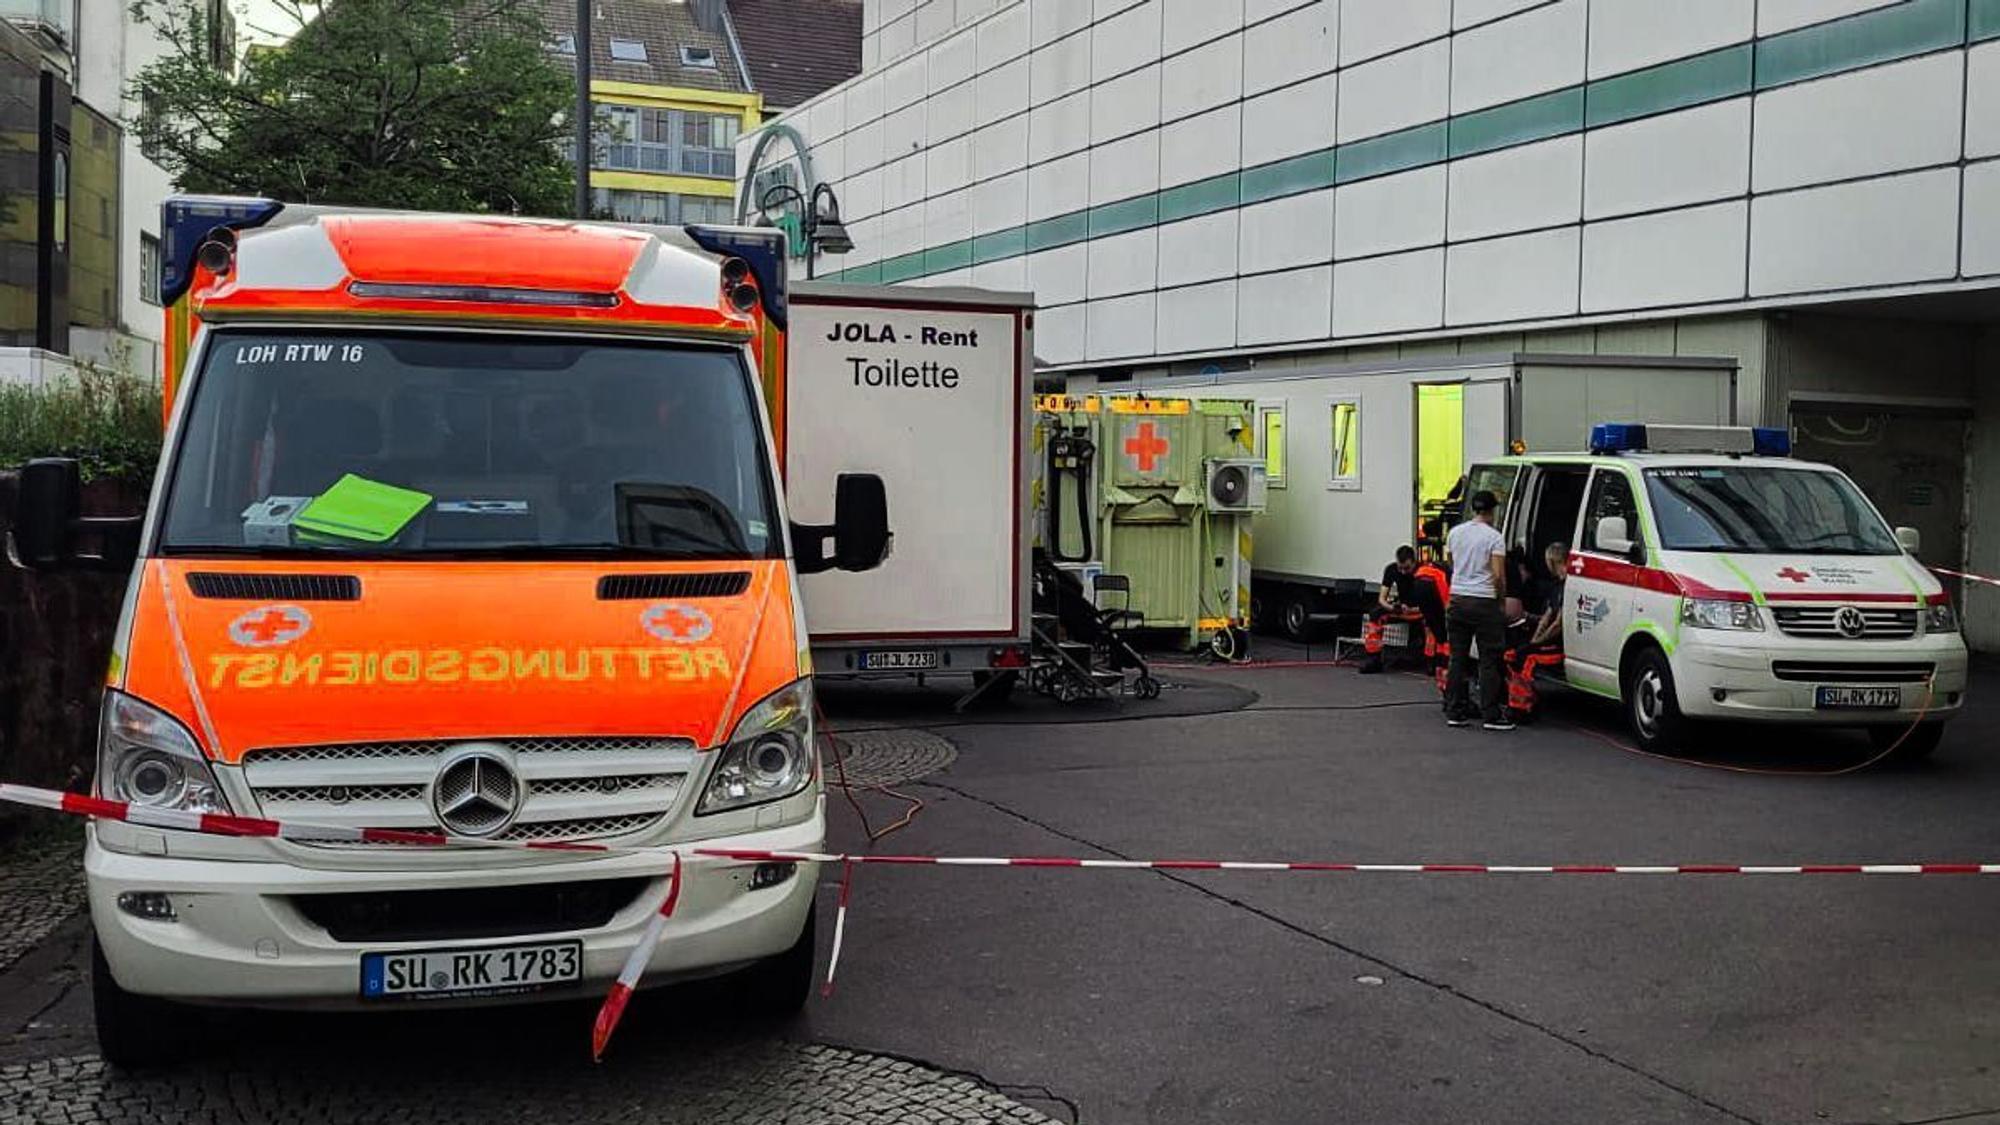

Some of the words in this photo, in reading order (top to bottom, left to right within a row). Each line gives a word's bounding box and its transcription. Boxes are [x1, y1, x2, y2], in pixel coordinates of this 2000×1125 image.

[827, 322, 897, 343] JOLA
[921, 326, 978, 347] Rent
[236, 345, 277, 364] LOH
[284, 344, 333, 362] RTW
[341, 344, 363, 362] 16
[846, 357, 959, 388] Toilette
[387, 957, 426, 990] SU
[453, 954, 491, 986] RK
[501, 947, 576, 982] 1783
